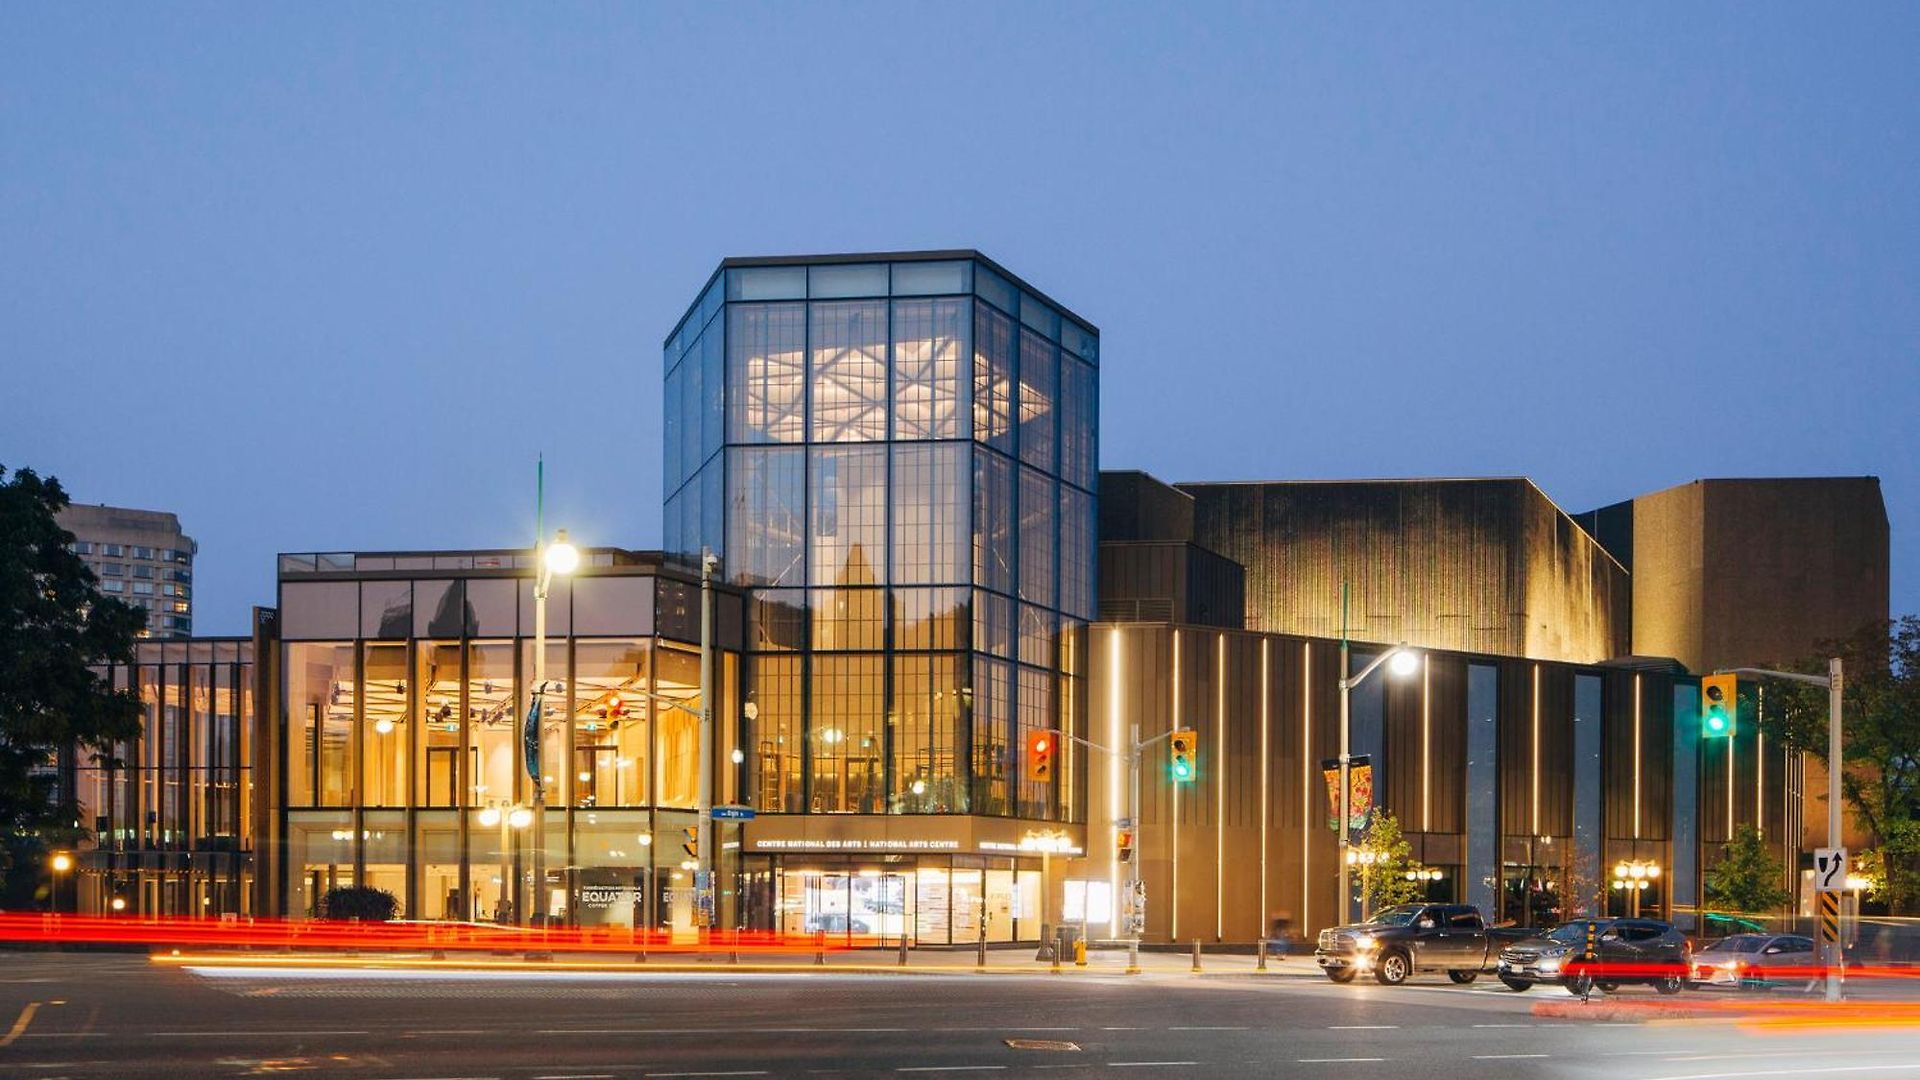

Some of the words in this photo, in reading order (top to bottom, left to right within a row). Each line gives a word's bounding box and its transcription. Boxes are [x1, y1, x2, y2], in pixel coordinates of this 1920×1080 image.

[757, 840, 785, 848] CENTRE
[787, 840, 825, 848] NATIONAL
[826, 840, 841, 848] DES
[842, 840, 862, 848] ARTS
[869, 840, 907, 848] NATIONAL
[909, 840, 928, 848] ARTS
[929, 840, 958, 848] CENTRE
[582, 891, 642, 902] EQUATOR
